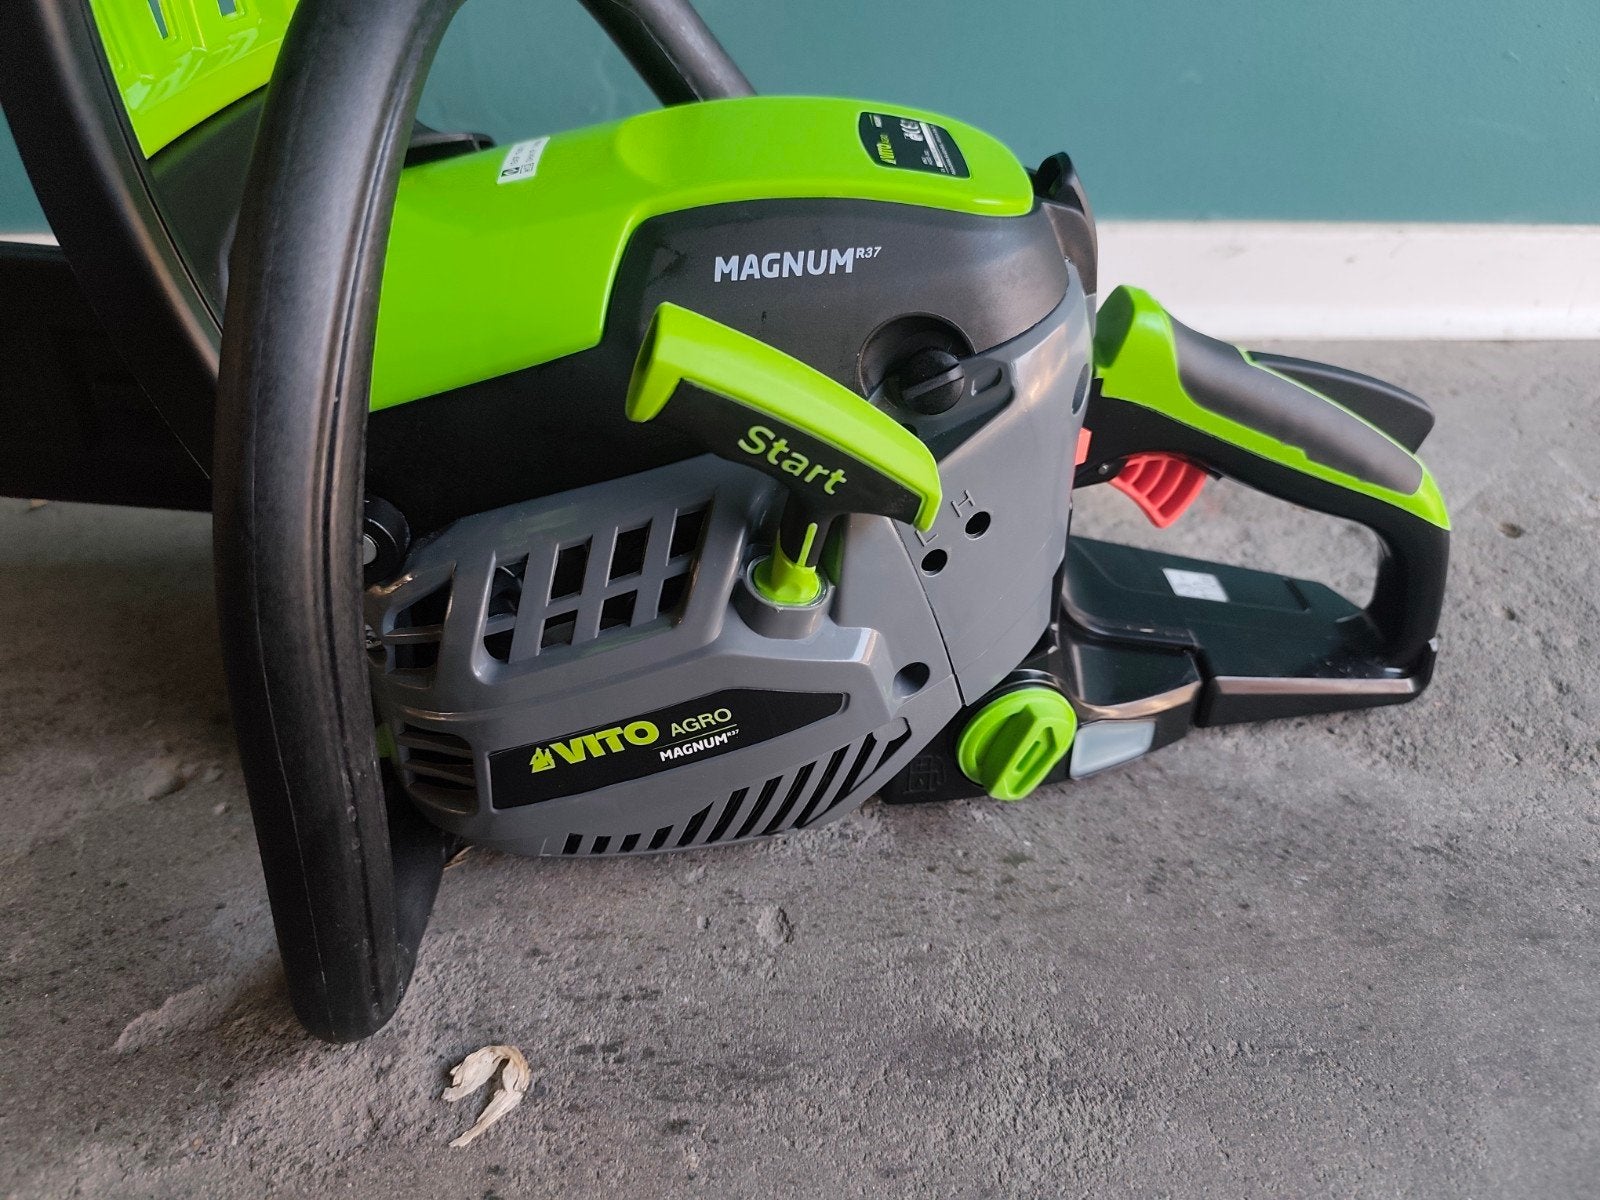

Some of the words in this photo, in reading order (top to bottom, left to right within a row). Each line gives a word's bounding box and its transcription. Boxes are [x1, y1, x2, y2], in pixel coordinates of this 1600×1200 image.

[737, 425, 847, 495] Start
[950, 489, 976, 518] H
[549, 720, 660, 764] VITO
[671, 708, 732, 737] AGRO
